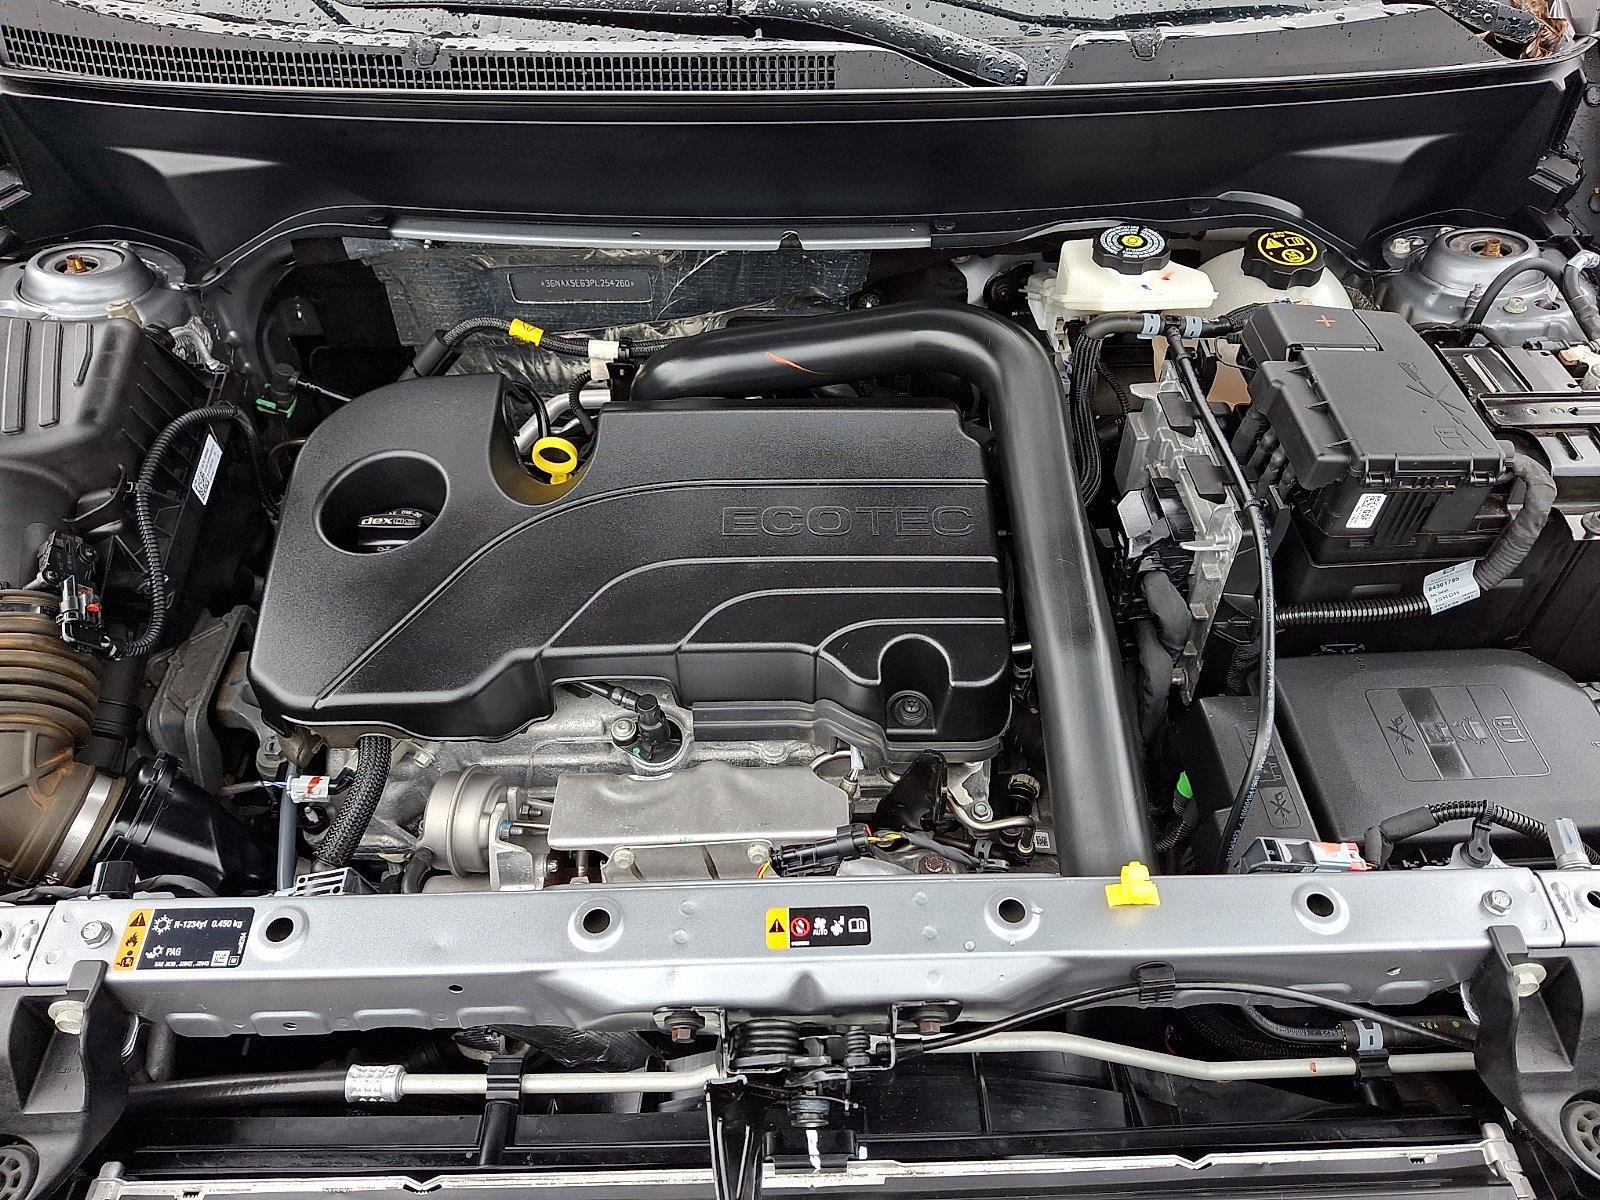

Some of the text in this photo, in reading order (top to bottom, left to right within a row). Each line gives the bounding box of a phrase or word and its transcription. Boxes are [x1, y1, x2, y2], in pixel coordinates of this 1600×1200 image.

[361, 516, 416, 526] dexos
[722, 506, 974, 536] ECOTEC
[173, 919, 243, 930] R-1234yf 0.450 kg
[813, 928, 828, 936] AUTO
[165, 947, 182, 956] PAG
